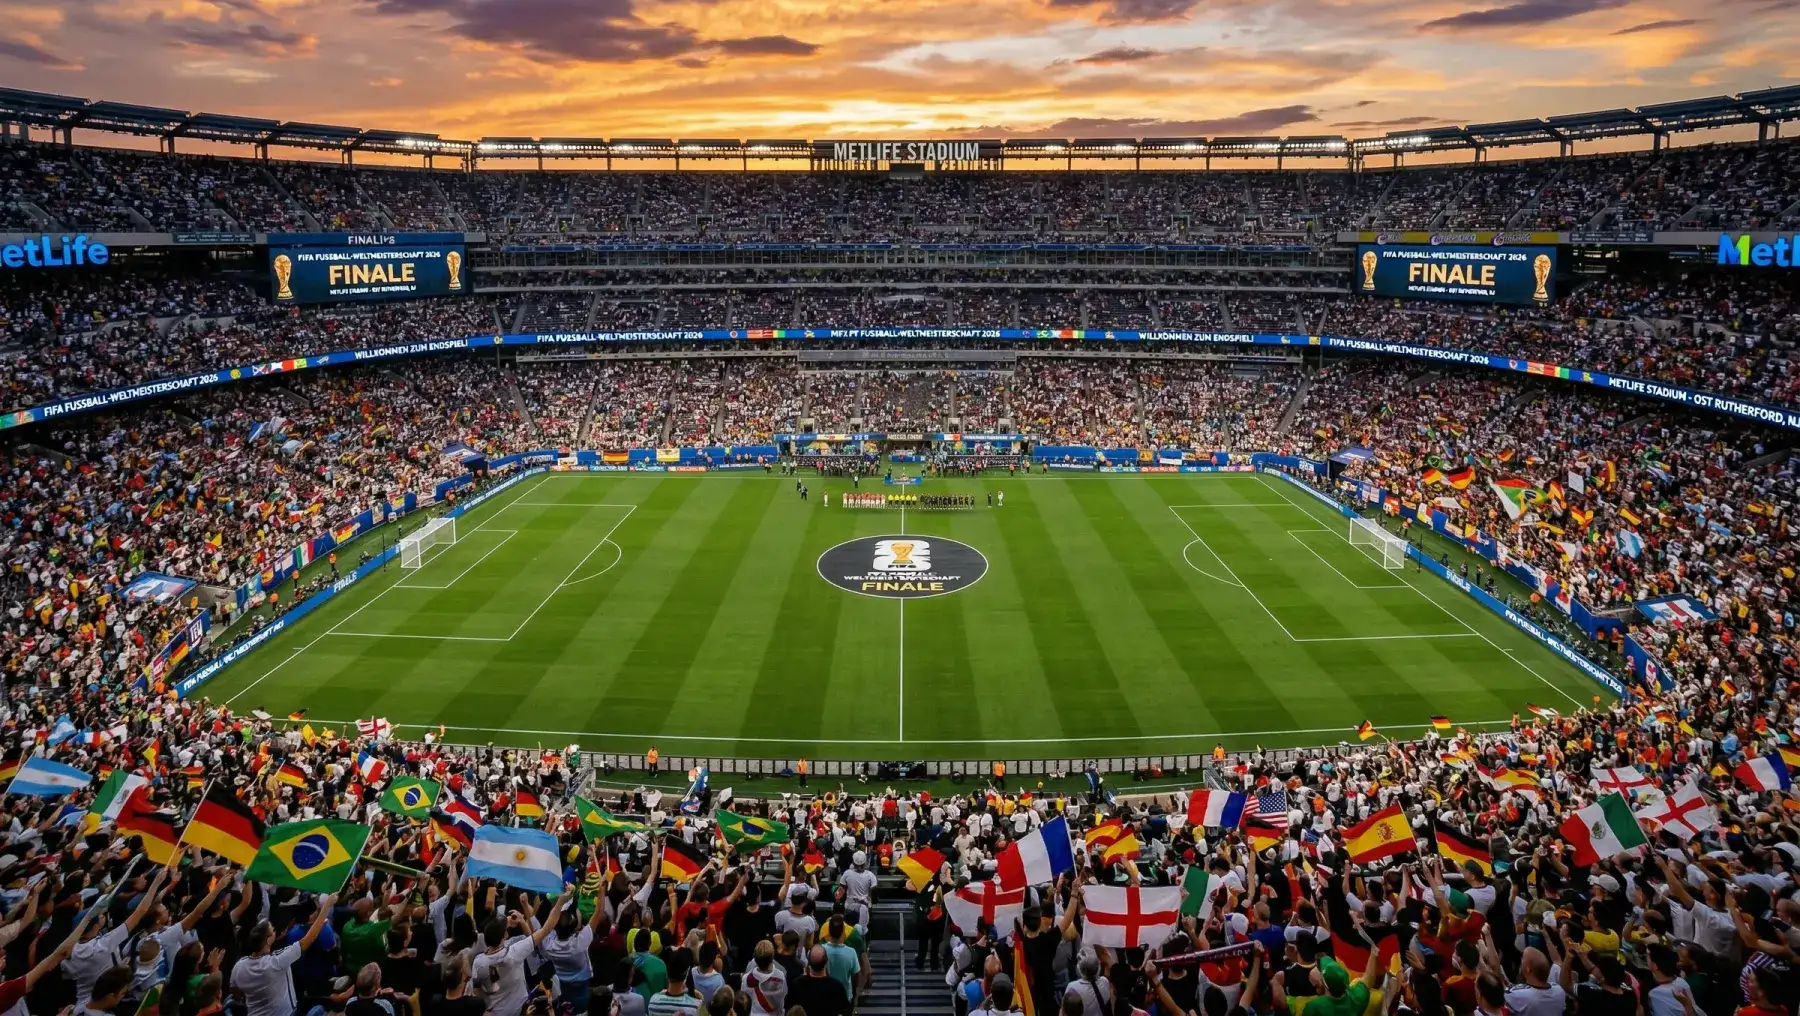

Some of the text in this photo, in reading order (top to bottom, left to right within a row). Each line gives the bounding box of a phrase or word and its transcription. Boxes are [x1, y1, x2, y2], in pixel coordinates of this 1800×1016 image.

[833, 142, 979, 161] METLIFE STADIUM
[0, 235, 109, 267] etLife
[329, 263, 416, 285] FINALE
[1409, 263, 1496, 286] FINALE
[43, 404, 64, 417] FIFA
[199, 373, 219, 385] 2026
[1646, 385, 1687, 401] STADIUM
[1694, 394, 1714, 407] OST
[1714, 399, 1786, 426] RUTHERFORD,
[861, 582, 944, 591] FINALE
